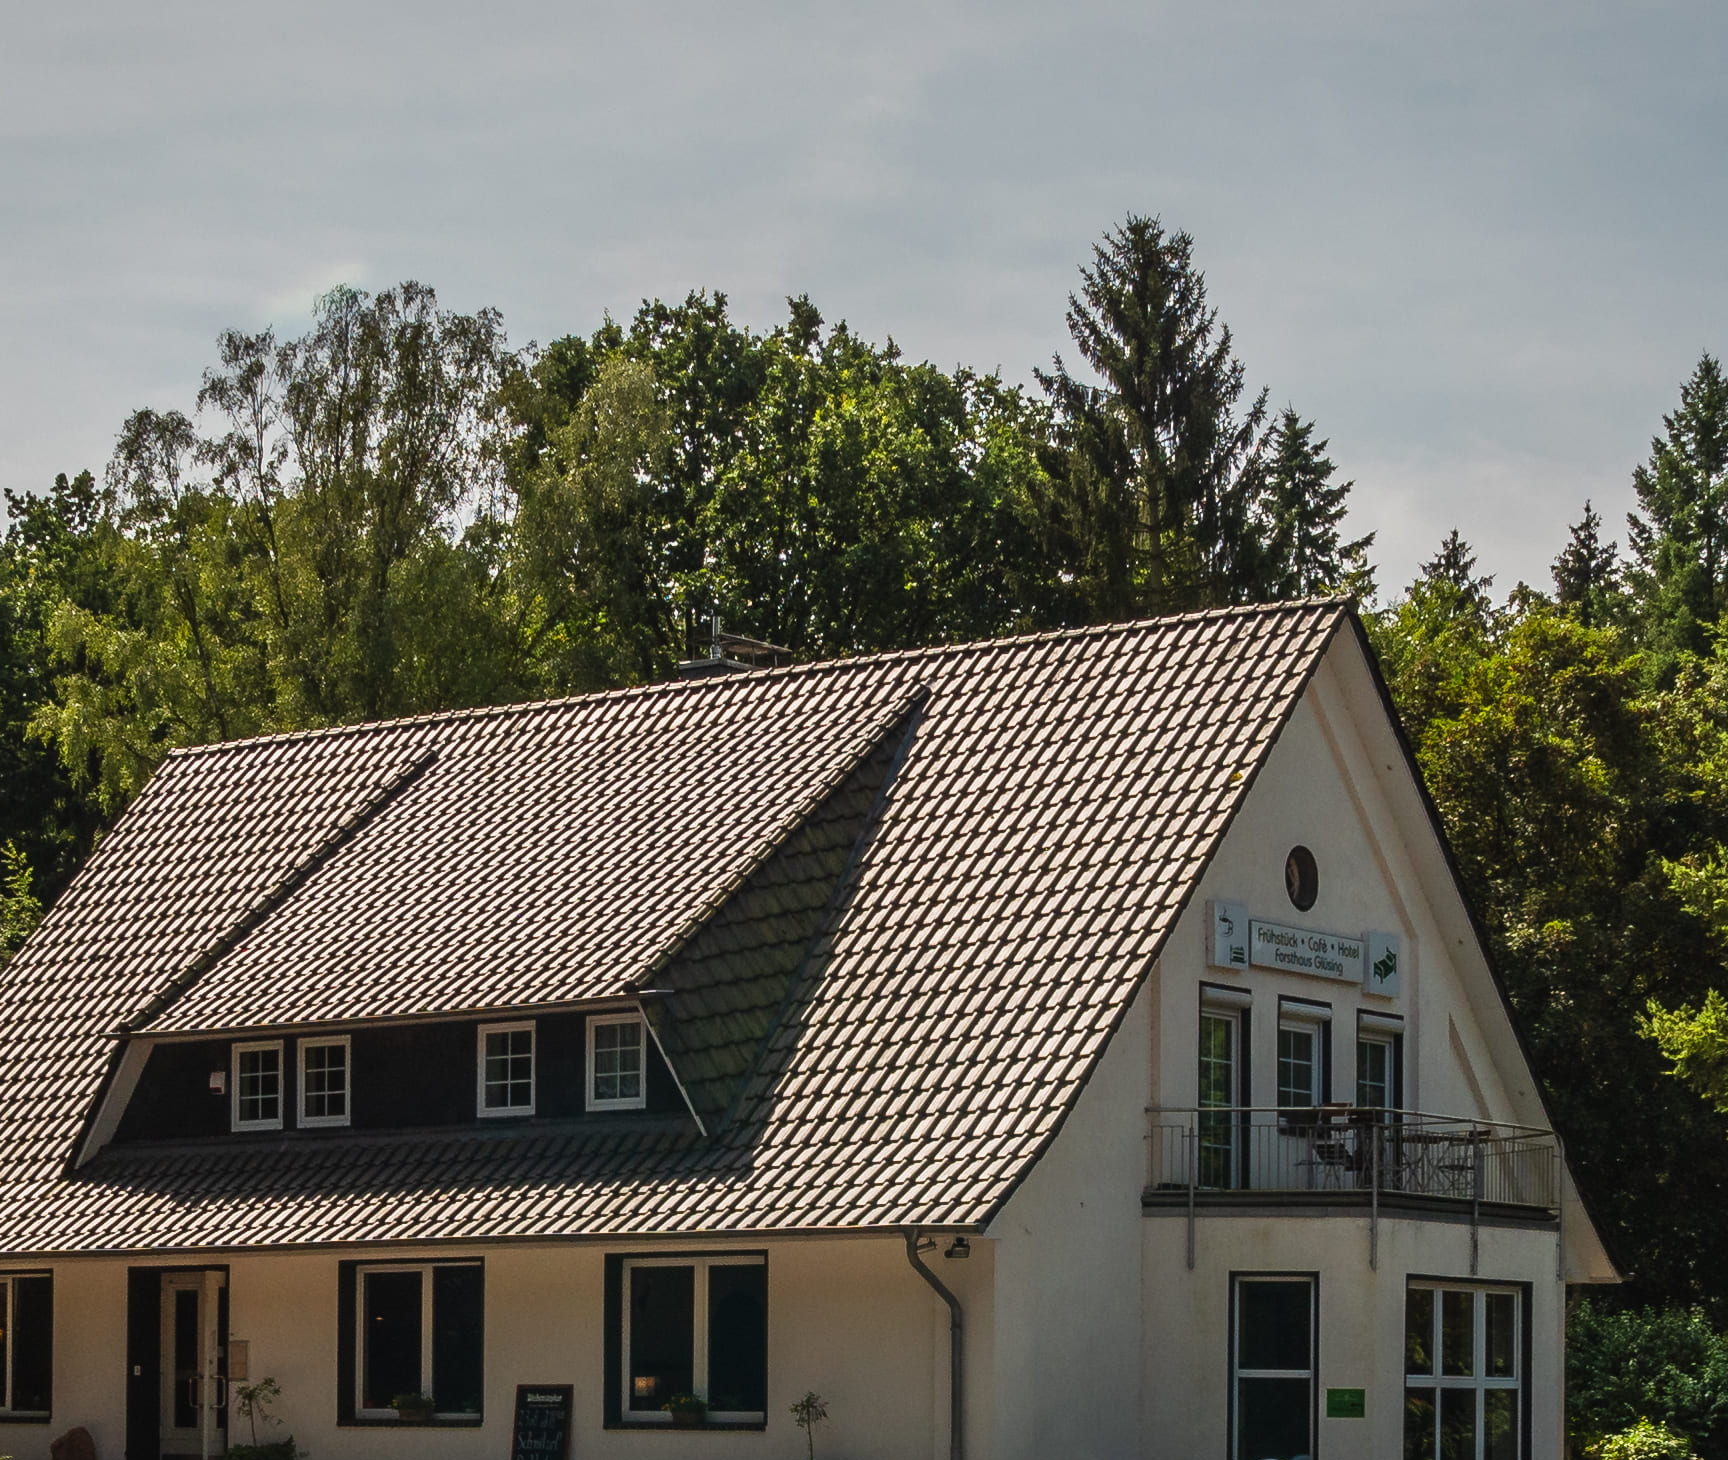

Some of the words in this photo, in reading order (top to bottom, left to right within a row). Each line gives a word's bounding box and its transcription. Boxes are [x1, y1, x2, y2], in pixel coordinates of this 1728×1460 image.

[1257, 927, 1298, 947] Frühstück
[1337, 942, 1360, 959] Hotel
[1275, 949, 1313, 967] Forsthaus
[1314, 956, 1343, 976] Glüsing
